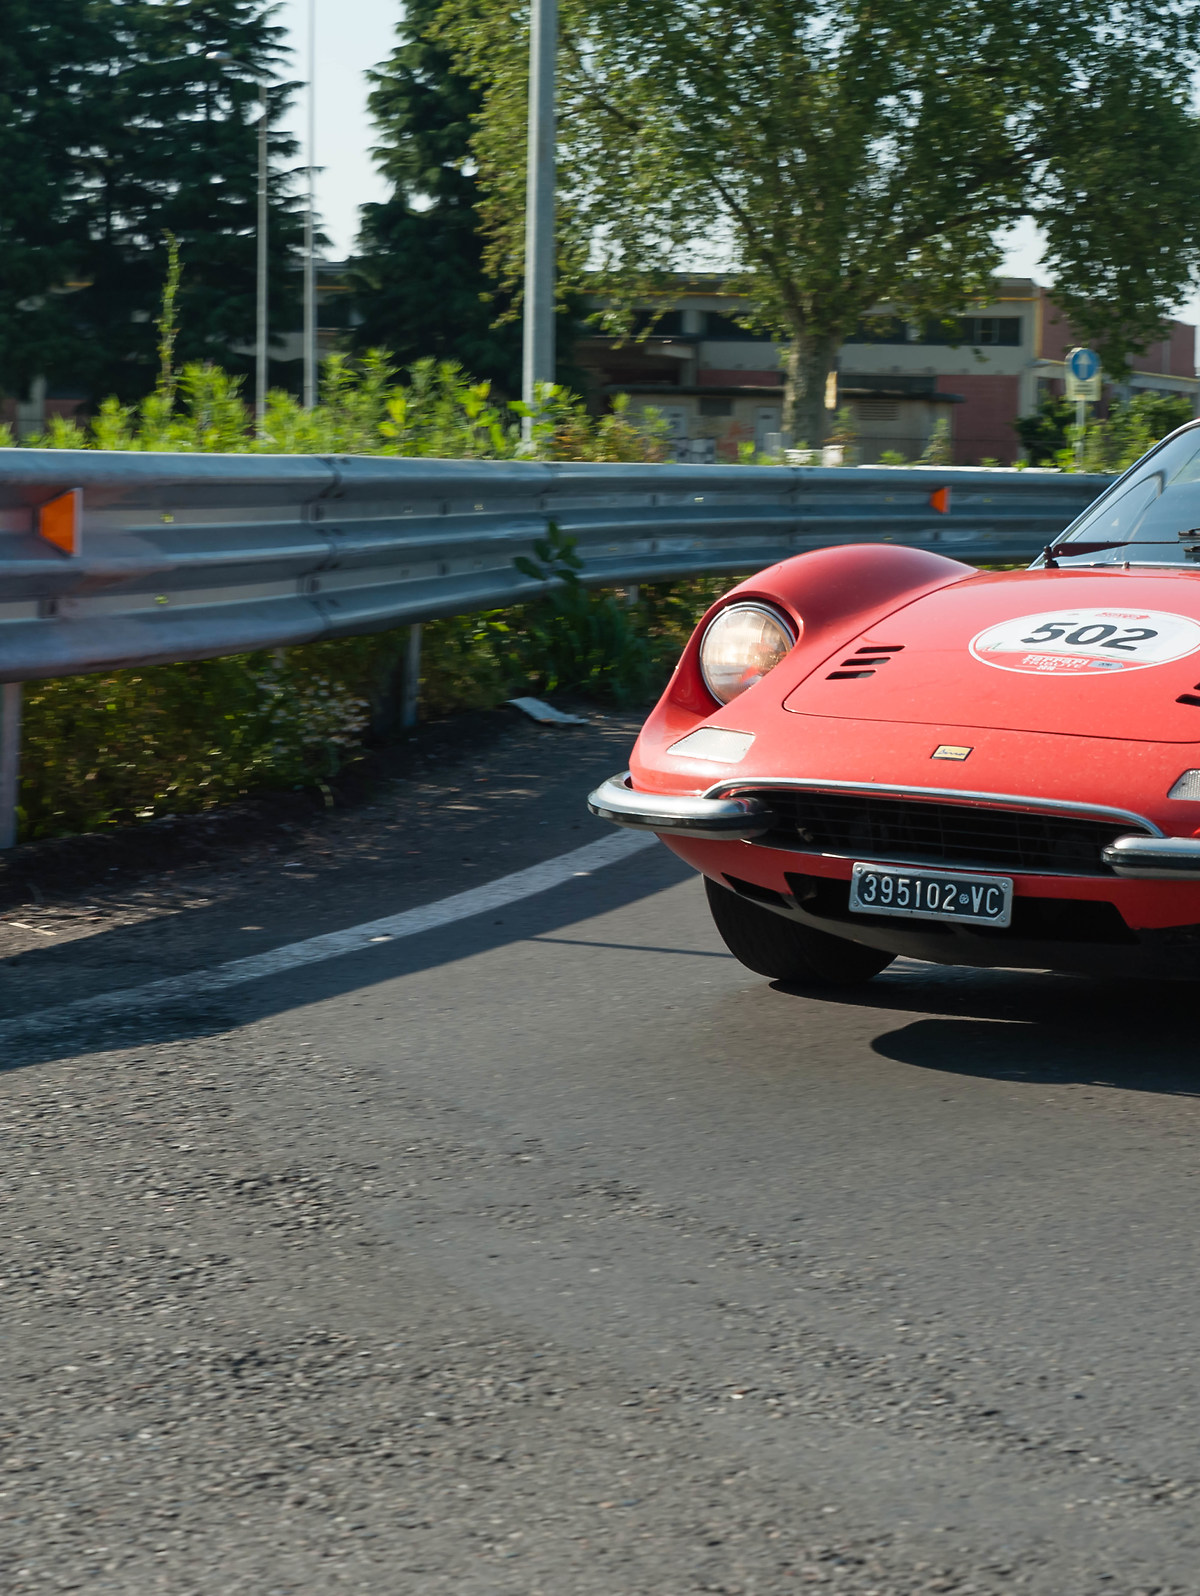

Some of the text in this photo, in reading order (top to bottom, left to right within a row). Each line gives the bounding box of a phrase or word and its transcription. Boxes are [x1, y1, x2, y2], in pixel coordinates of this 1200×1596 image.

[1020, 622, 1158, 651] 502
[864, 873, 999, 915] 395102 VC
